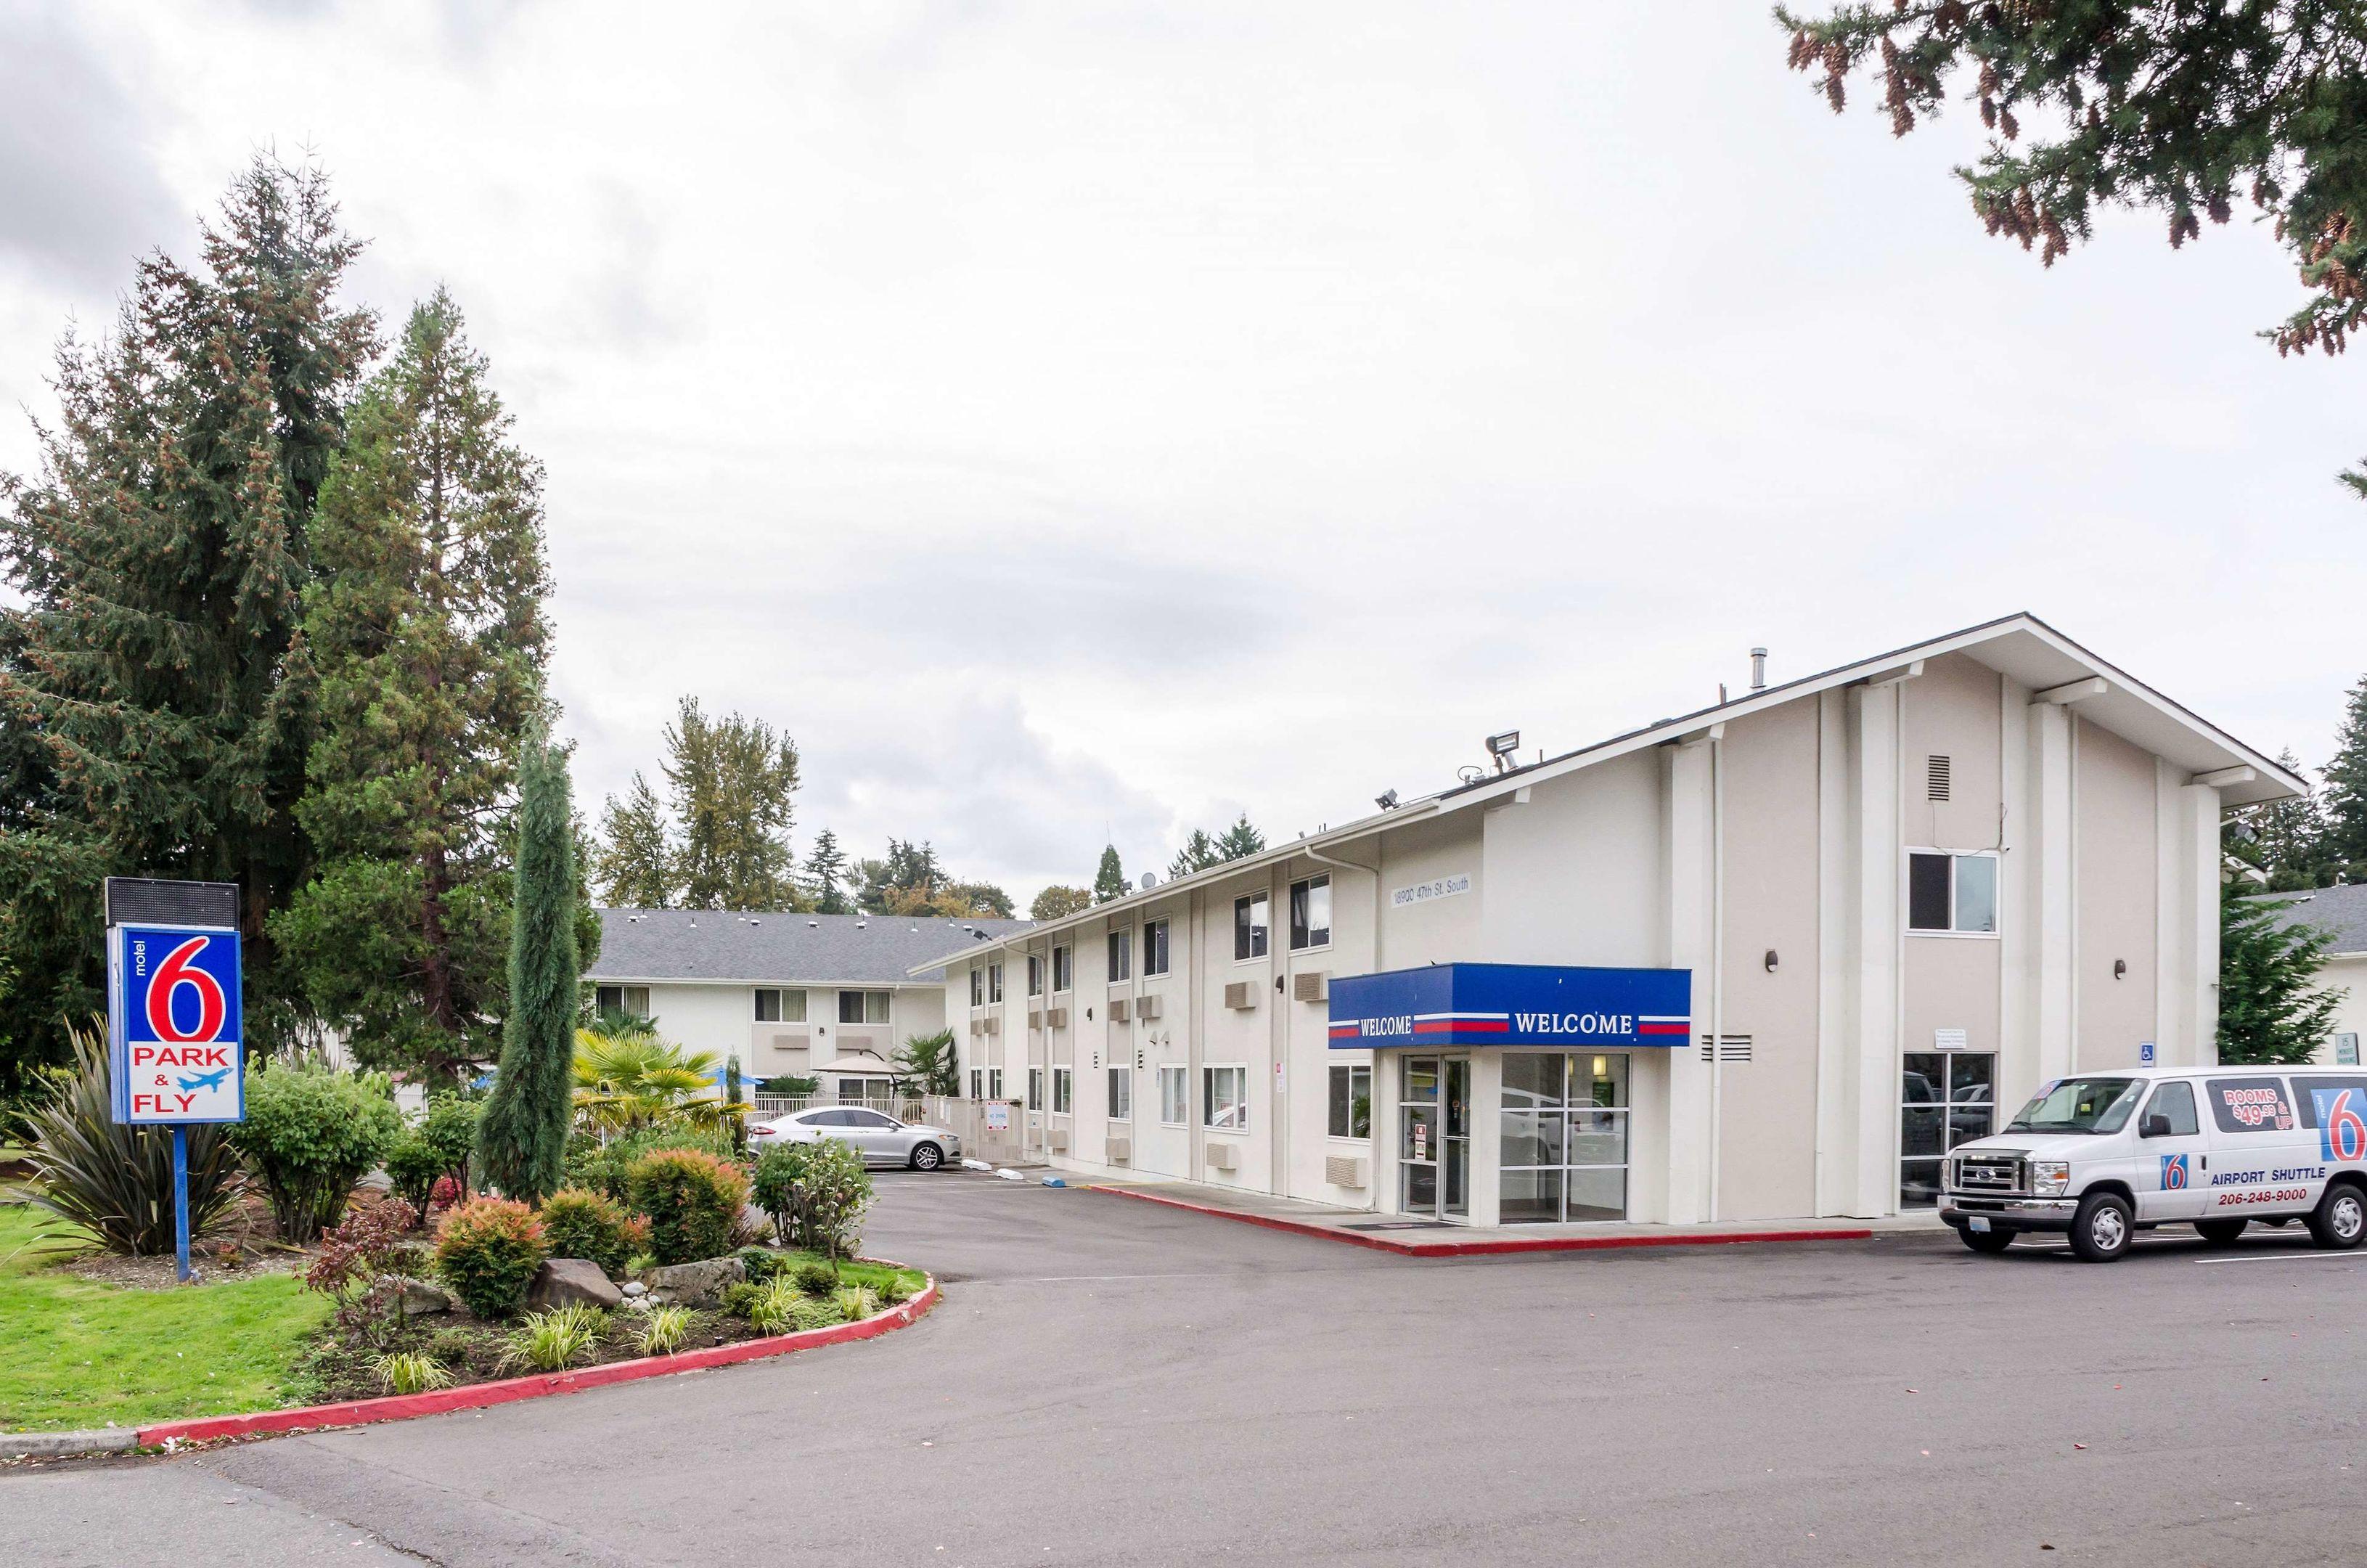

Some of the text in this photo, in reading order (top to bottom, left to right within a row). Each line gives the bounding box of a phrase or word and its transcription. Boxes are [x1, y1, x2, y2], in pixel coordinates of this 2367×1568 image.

[1394, 877, 1468, 905] 18900 47th St. South
[133, 935, 226, 1042] motel 6
[1360, 1015, 1412, 1037] WELCOME
[1514, 1013, 1632, 1034] WELCOME
[134, 1047, 229, 1067] PARK
[155, 1074, 169, 1087] &
[134, 1094, 197, 1114] FLY
[2223, 1088, 2278, 1106] ROOMS
[2233, 1101, 2288, 1125] $49.99 &
[2275, 1115, 2293, 1130] UP
[2315, 1089, 2366, 1161] motel 6
[2165, 1155, 2186, 1191] 6
[2211, 1167, 2326, 1185] AIRPORT SHUTTLE
[2218, 1188, 2307, 1206] 206-248-9000
